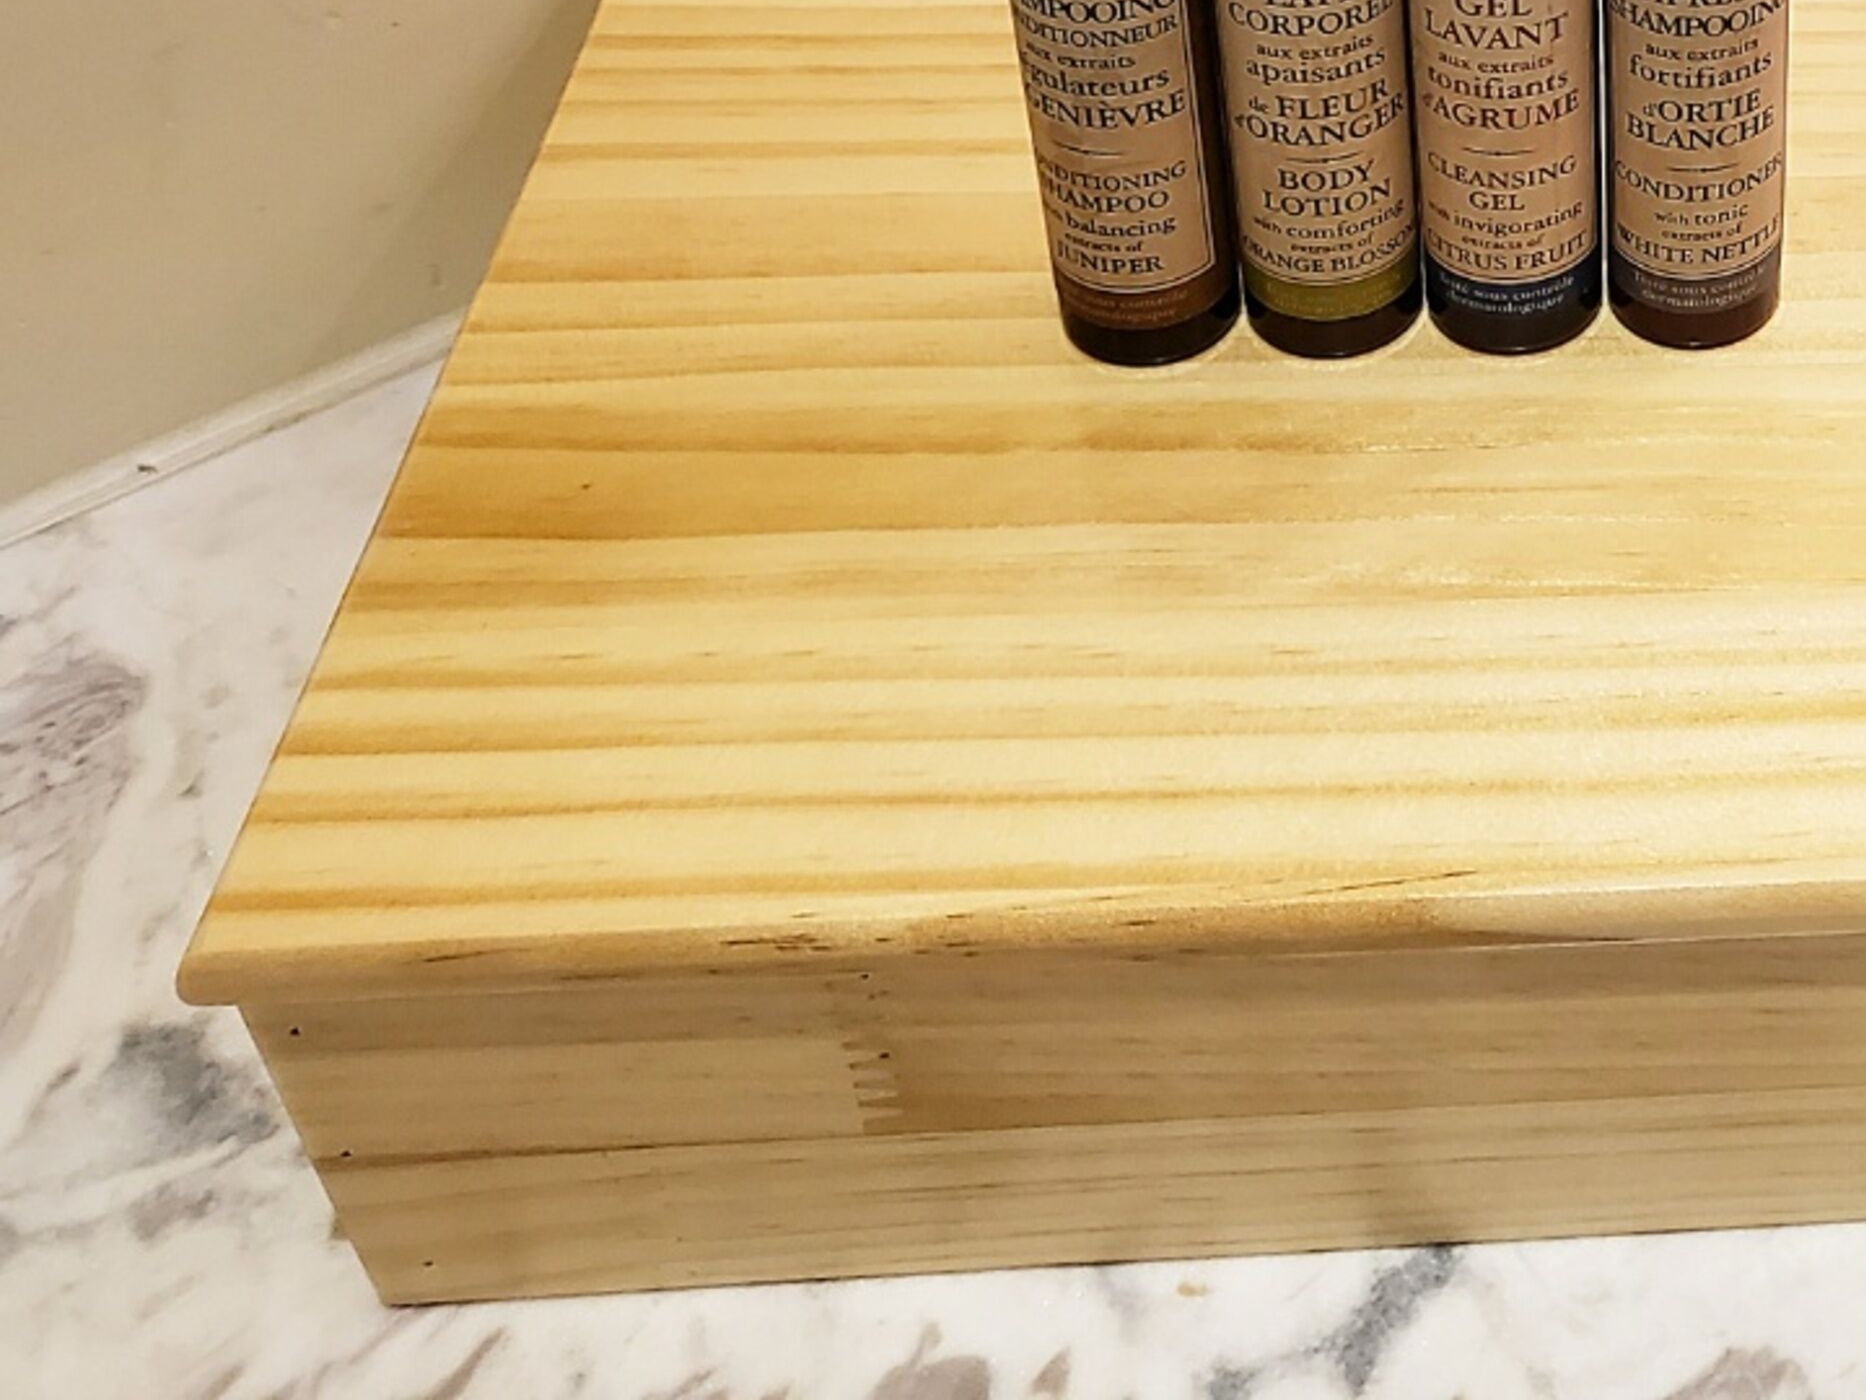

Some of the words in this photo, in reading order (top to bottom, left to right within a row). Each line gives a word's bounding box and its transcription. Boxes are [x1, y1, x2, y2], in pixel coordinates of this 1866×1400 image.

[1257, 44, 1293, 60] aux
[1299, 34, 1375, 60] extraits
[1424, 8, 1569, 49] LAVANT
[1246, 48, 1385, 85] apaisants
[1438, 52, 1471, 70] aux
[1477, 54, 1554, 74] extraits
[1646, 43, 1681, 61] aux
[1687, 38, 1758, 61] extraits
[1428, 66, 1569, 100] tonifiants
[1630, 52, 1772, 89] fortifiants
[1034, 89, 1186, 128] ENIÈVRE
[1275, 78, 1388, 120] FLEUR
[1626, 106, 1774, 150] BLANCHE
[1278, 159, 1374, 191] BODY
[1428, 152, 1577, 189] CLEANSING
[1615, 153, 1782, 202] CONDITIONER
[1048, 179, 1169, 213] HAMPOO
[1263, 177, 1391, 217] LOTION
[1469, 192, 1525, 211] GEL
[1065, 212, 1176, 238] balancing
[1286, 198, 1404, 240] comforting
[1453, 202, 1583, 238] invigorating
[1695, 204, 1748, 226] tonic
[1057, 240, 1164, 274] JUNIPER
[1515, 229, 1587, 271] FRUIT
[1617, 223, 1694, 264] WHITE
